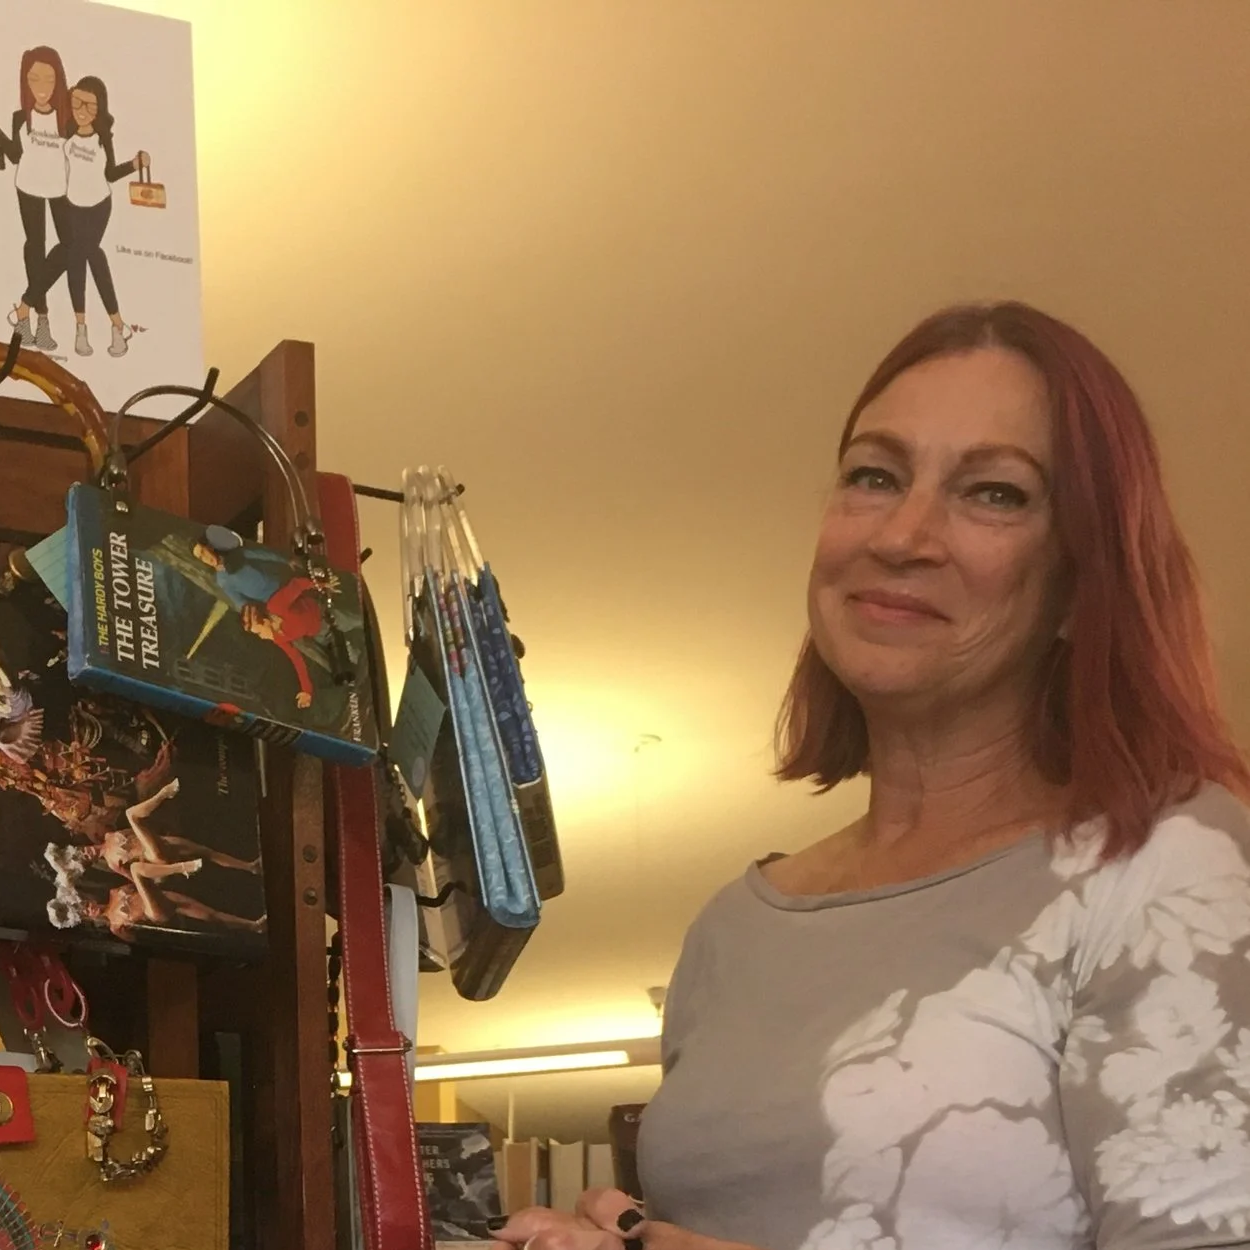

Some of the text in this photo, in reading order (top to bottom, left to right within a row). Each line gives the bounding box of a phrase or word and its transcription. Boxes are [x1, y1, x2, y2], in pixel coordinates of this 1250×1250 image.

[92, 546, 105, 580] BOYS
[95, 581, 108, 621] HARDY
[109, 530, 136, 661] THE TOWER
[135, 556, 160, 669] TREASURE
[97, 622, 109, 645] THE
[348, 690, 362, 742] FRANKLIN
